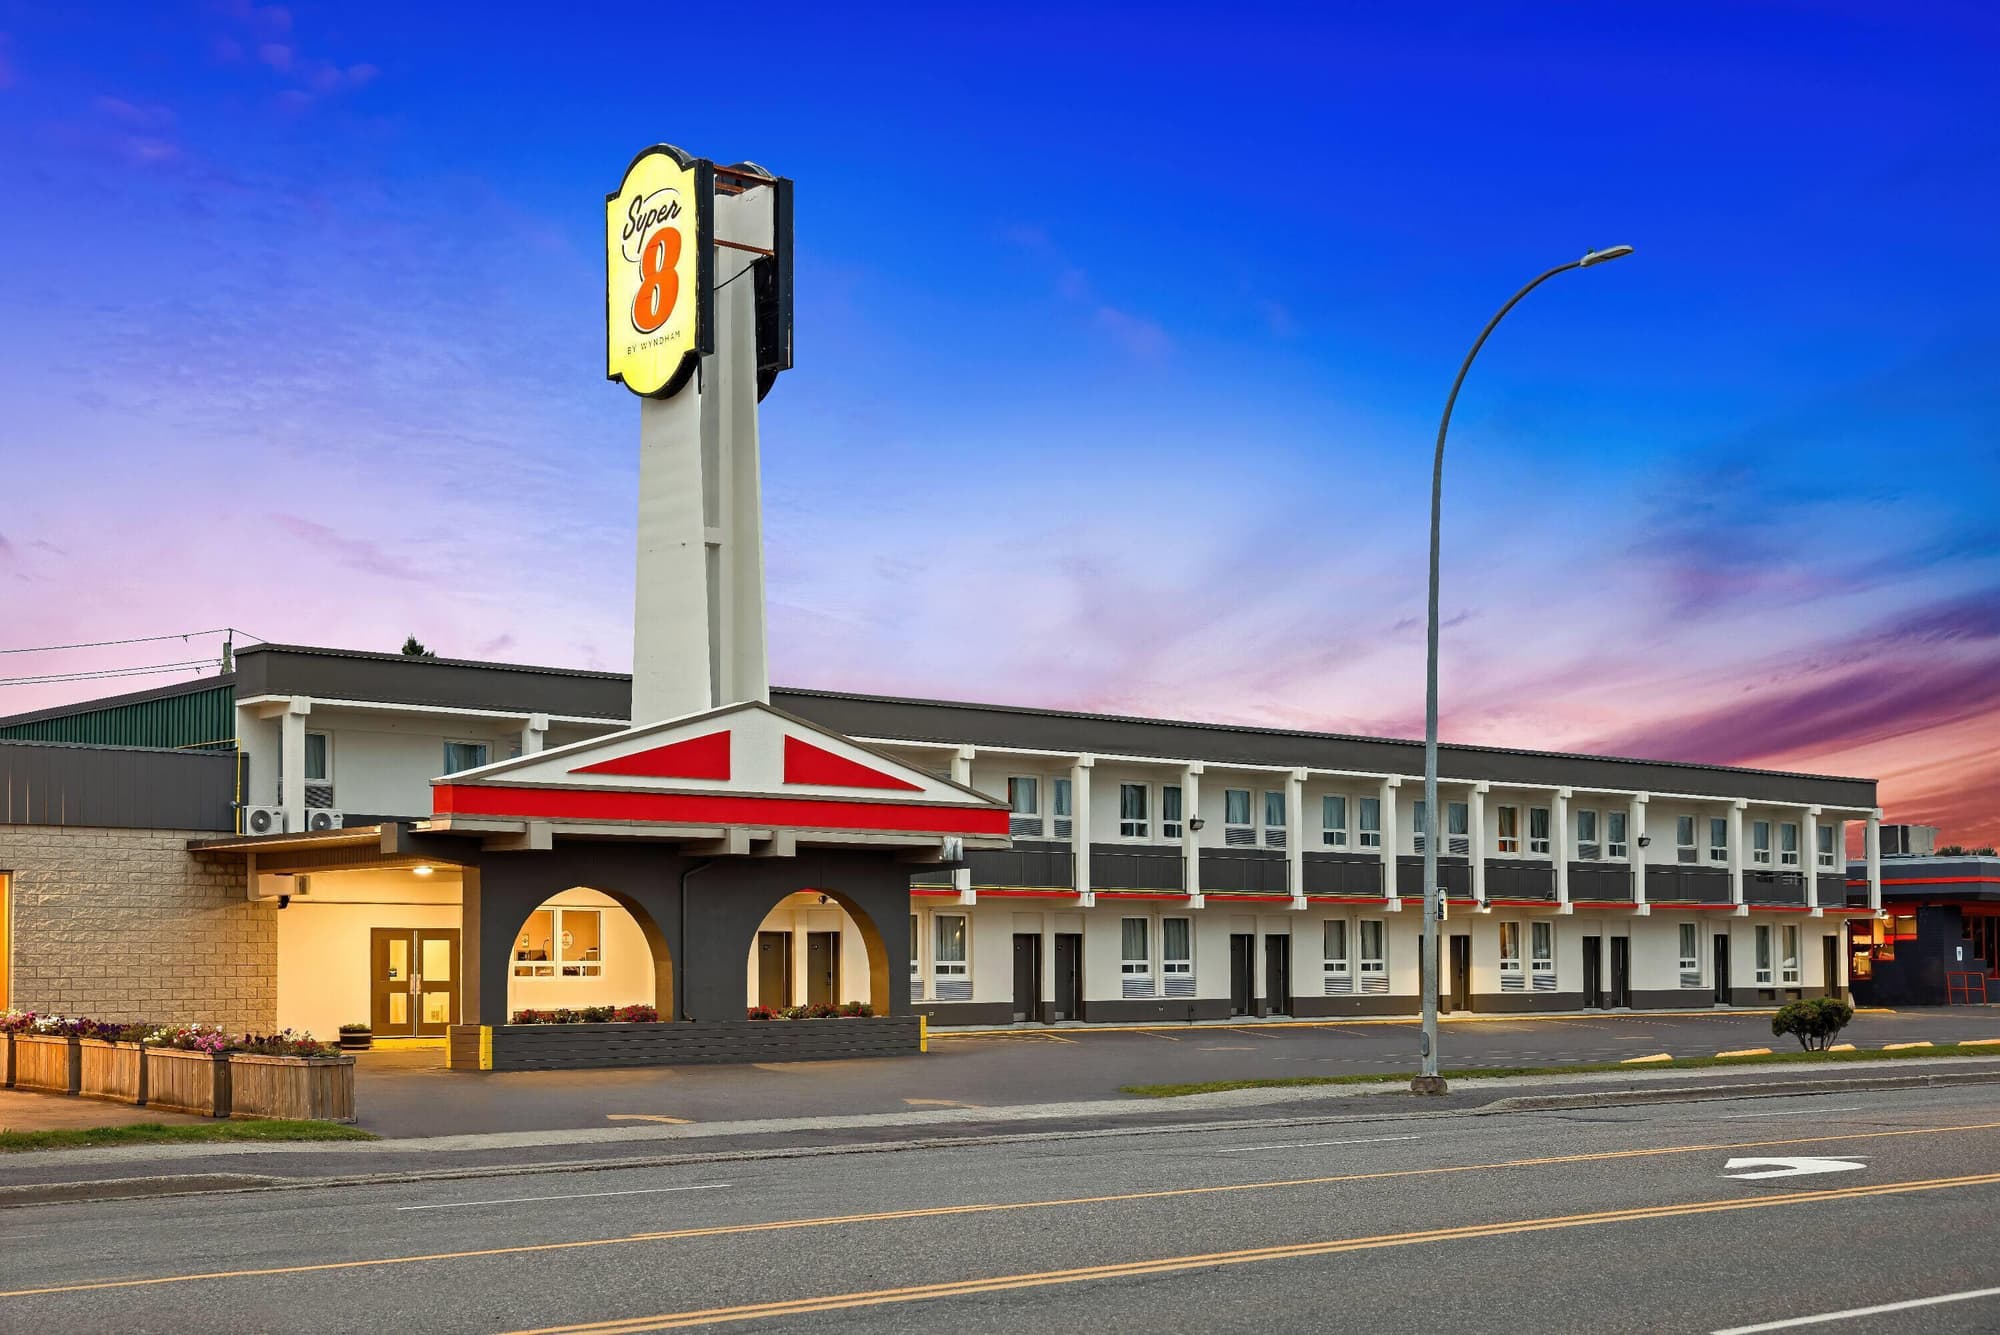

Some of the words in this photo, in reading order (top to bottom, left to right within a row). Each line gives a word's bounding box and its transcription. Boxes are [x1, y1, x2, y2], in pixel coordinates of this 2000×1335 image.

[623, 192, 682, 254] Super
[631, 226, 682, 334] 8
[627, 344, 637, 356] BY
[640, 331, 681, 351] WYNDHAM
